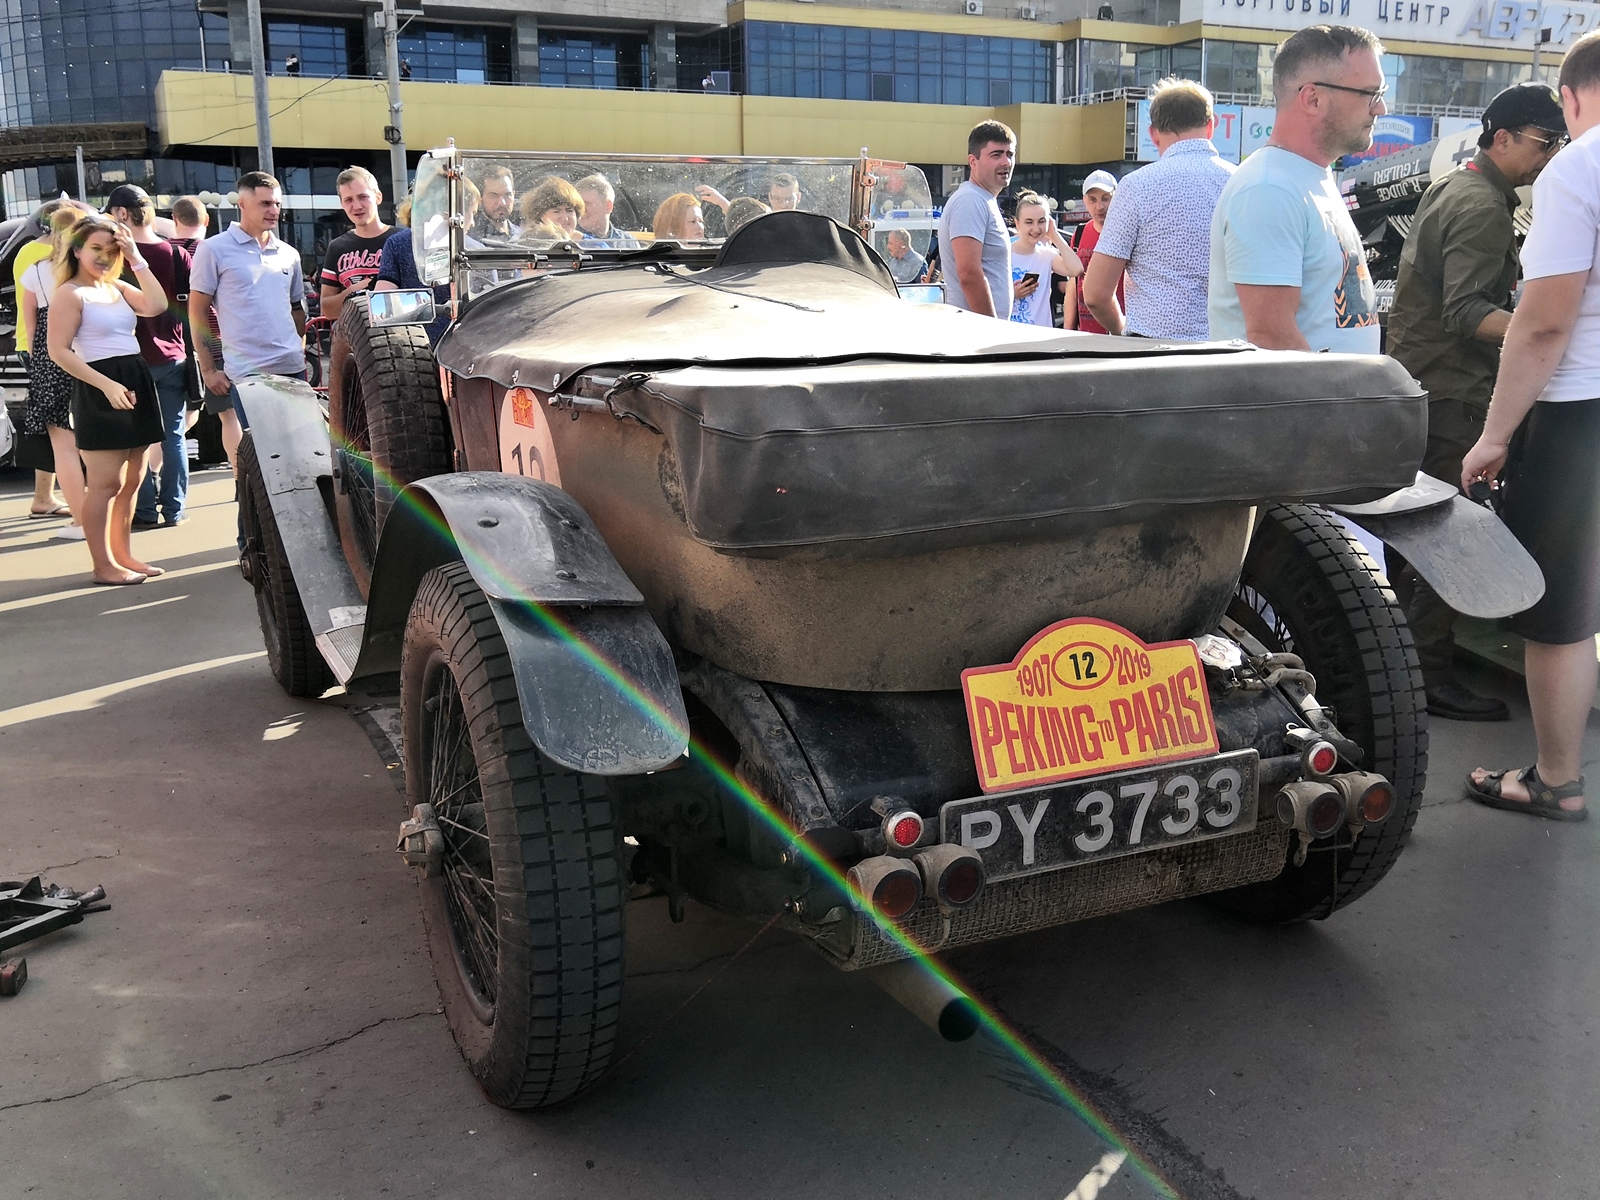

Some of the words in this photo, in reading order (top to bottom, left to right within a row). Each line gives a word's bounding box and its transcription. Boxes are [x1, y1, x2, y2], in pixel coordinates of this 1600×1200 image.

[1378, 0, 1450, 25] ЦЕНТР
[337, 248, 383, 273] Athlet
[1016, 653, 1053, 698] 1907
[1069, 651, 1098, 681] 12
[1113, 643, 1151, 686] 2019
[975, 695, 1104, 779] PEKING
[1097, 718, 1114, 743] TO
[1109, 665, 1208, 756] PARIS
[960, 799, 1051, 866] PY
[1074, 768, 1242, 853] 3733
